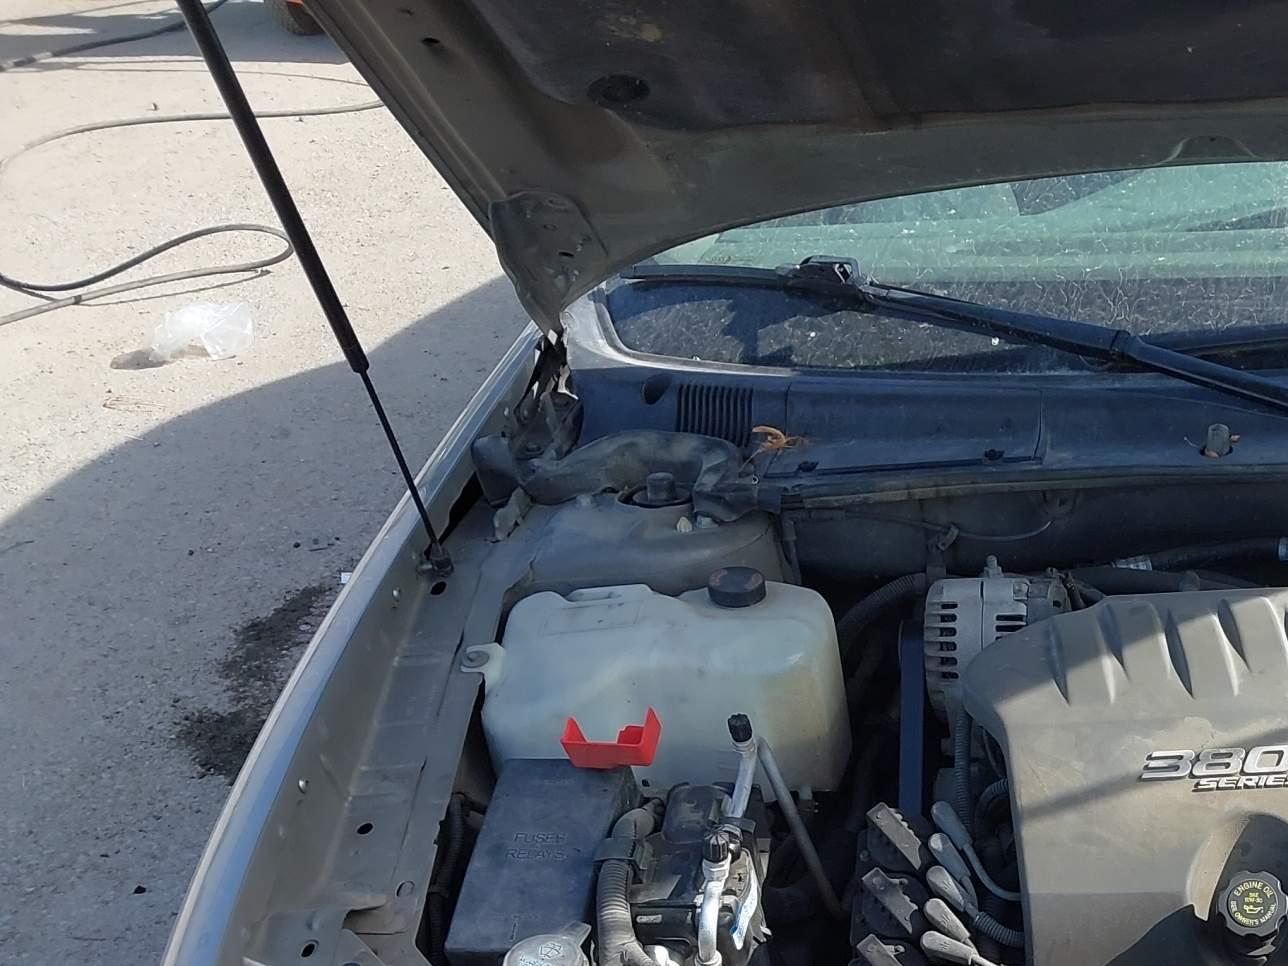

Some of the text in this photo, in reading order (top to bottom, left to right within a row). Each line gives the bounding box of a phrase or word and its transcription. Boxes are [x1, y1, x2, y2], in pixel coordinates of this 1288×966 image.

[513, 831, 566, 844] FUSES
[505, 847, 567, 860] RELAYS
[1233, 880, 1274, 899] ENGINE OIL
[1259, 903, 1277, 924] MANUAL
